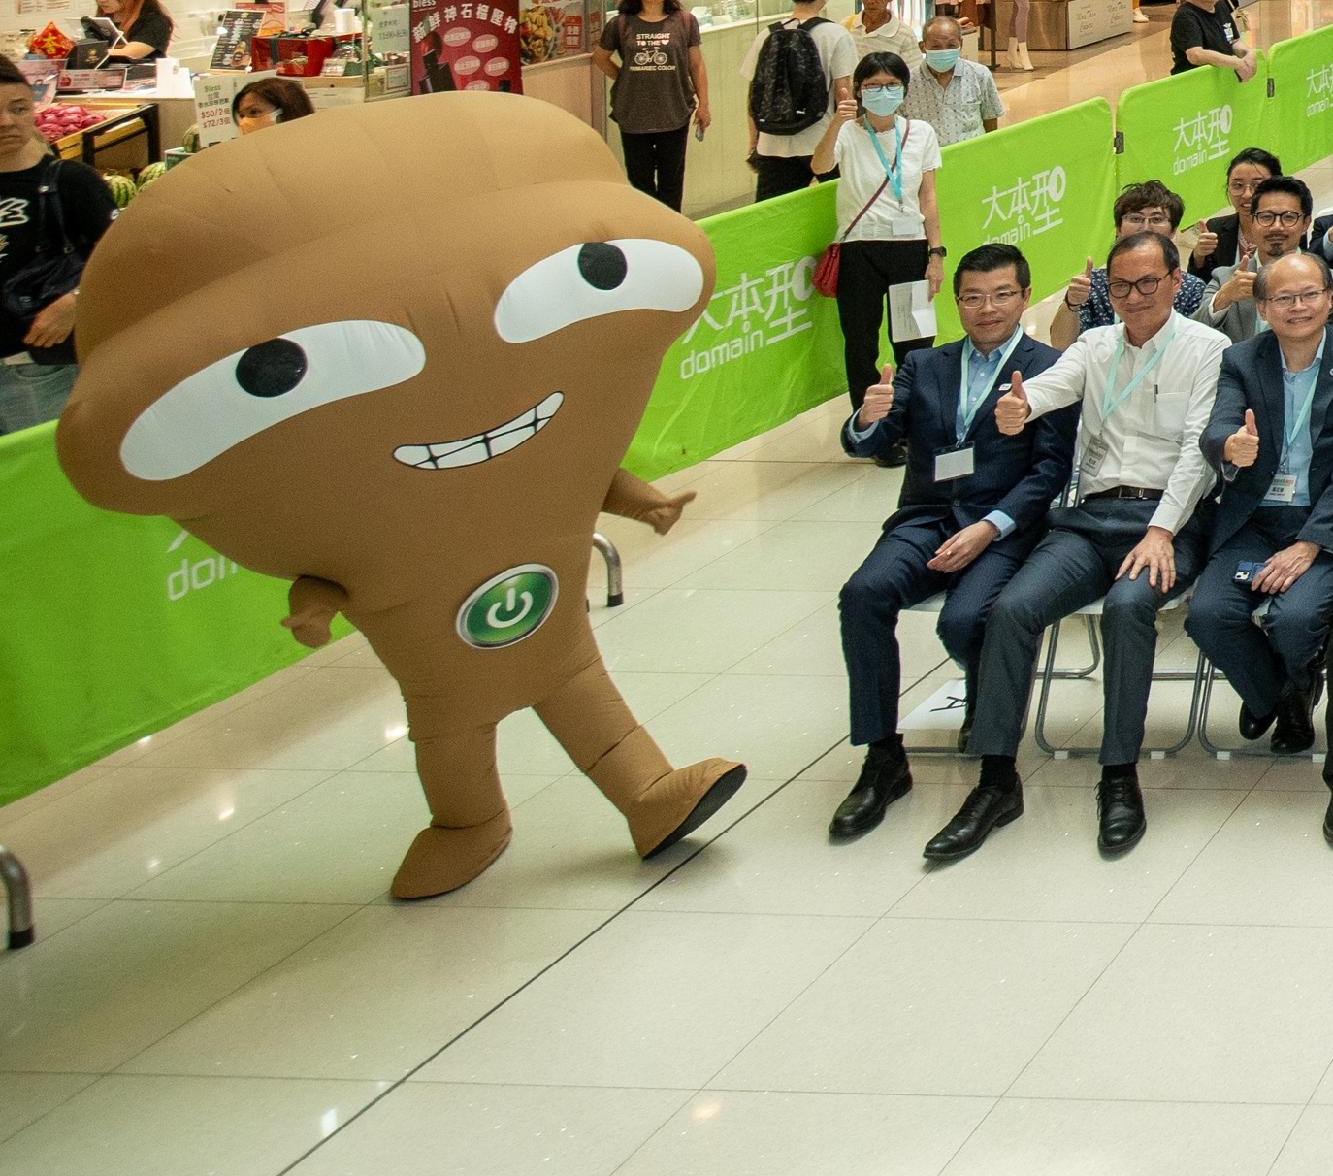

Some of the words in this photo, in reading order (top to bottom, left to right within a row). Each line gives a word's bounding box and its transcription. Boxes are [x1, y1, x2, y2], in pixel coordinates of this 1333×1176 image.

[1173, 104, 1233, 160] 大本型
[1173, 140, 1208, 177] domain
[982, 166, 1066, 235] 大本型
[680, 321, 765, 380] domain
